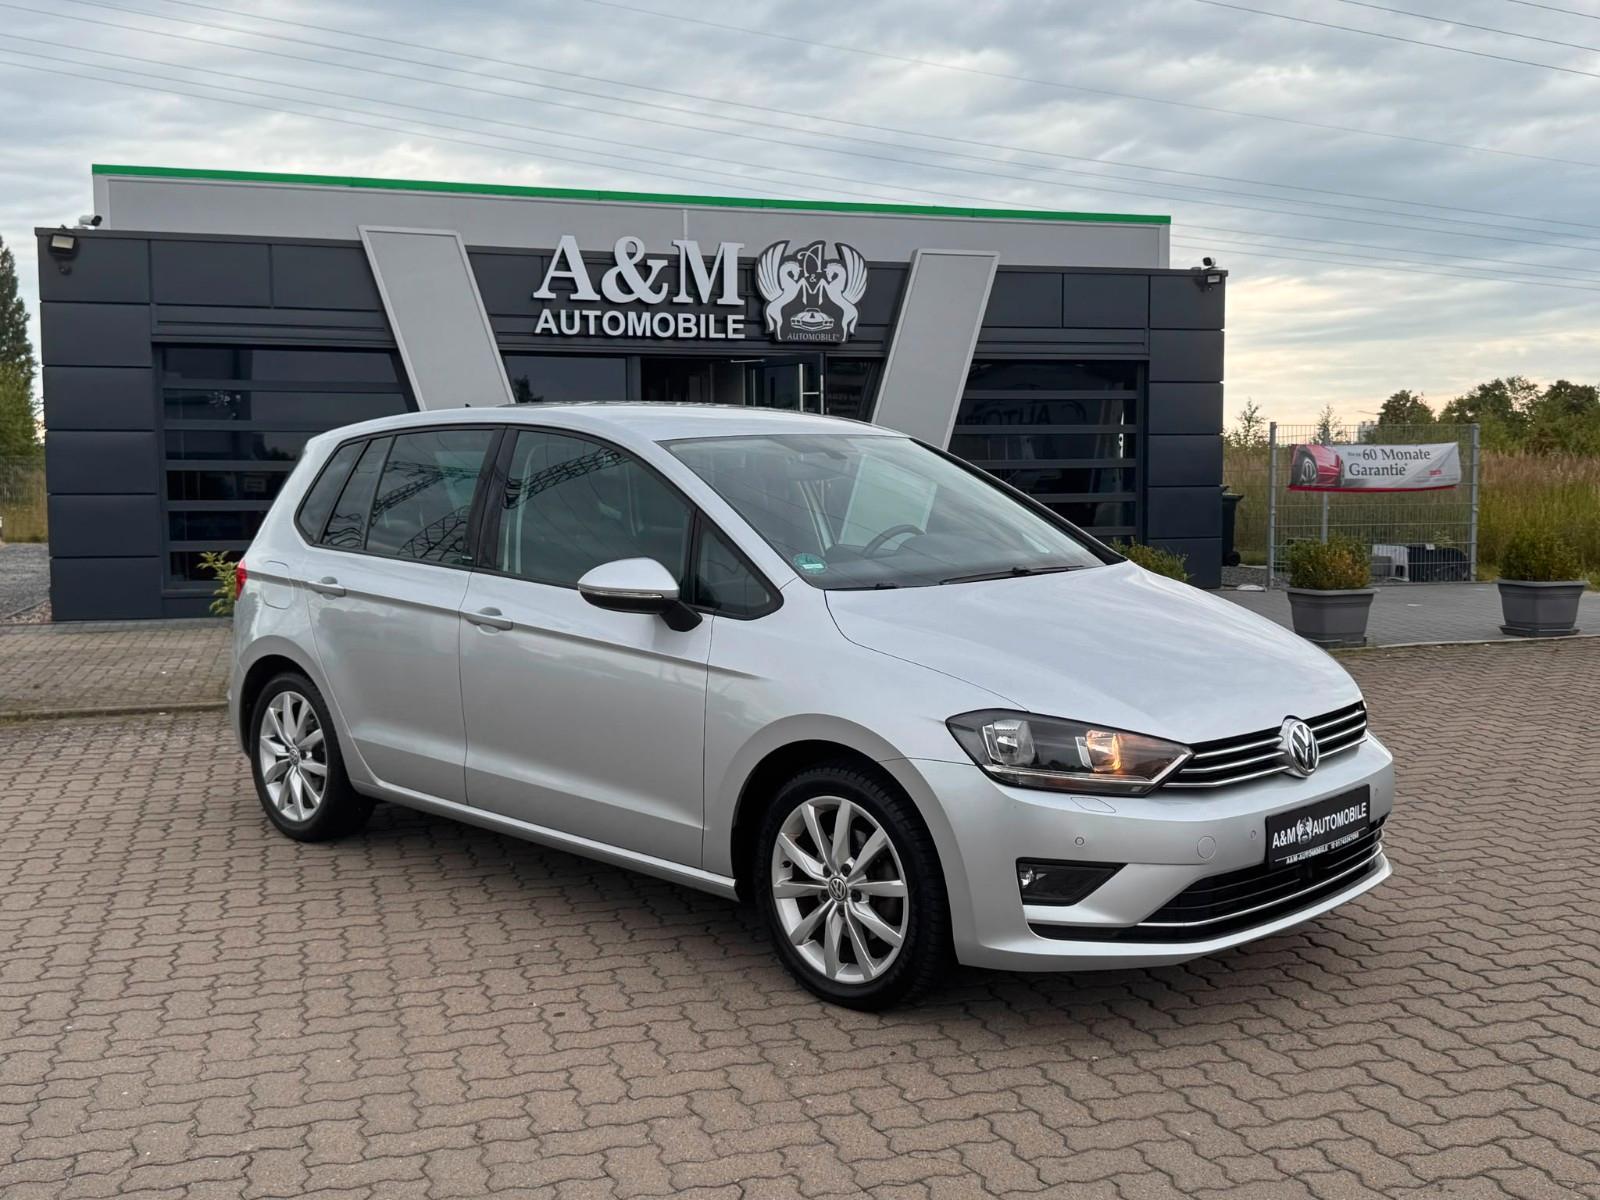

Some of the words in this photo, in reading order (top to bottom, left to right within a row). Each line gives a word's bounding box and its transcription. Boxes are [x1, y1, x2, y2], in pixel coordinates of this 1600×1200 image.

[533, 235, 745, 305] A&M
[534, 309, 746, 339] AUTOMOBILE
[1362, 448, 1377, 461] 60
[1379, 448, 1431, 460] Monate
[1272, 826, 1296, 849] A&M
[1312, 802, 1367, 837] AUTOMOBILE
